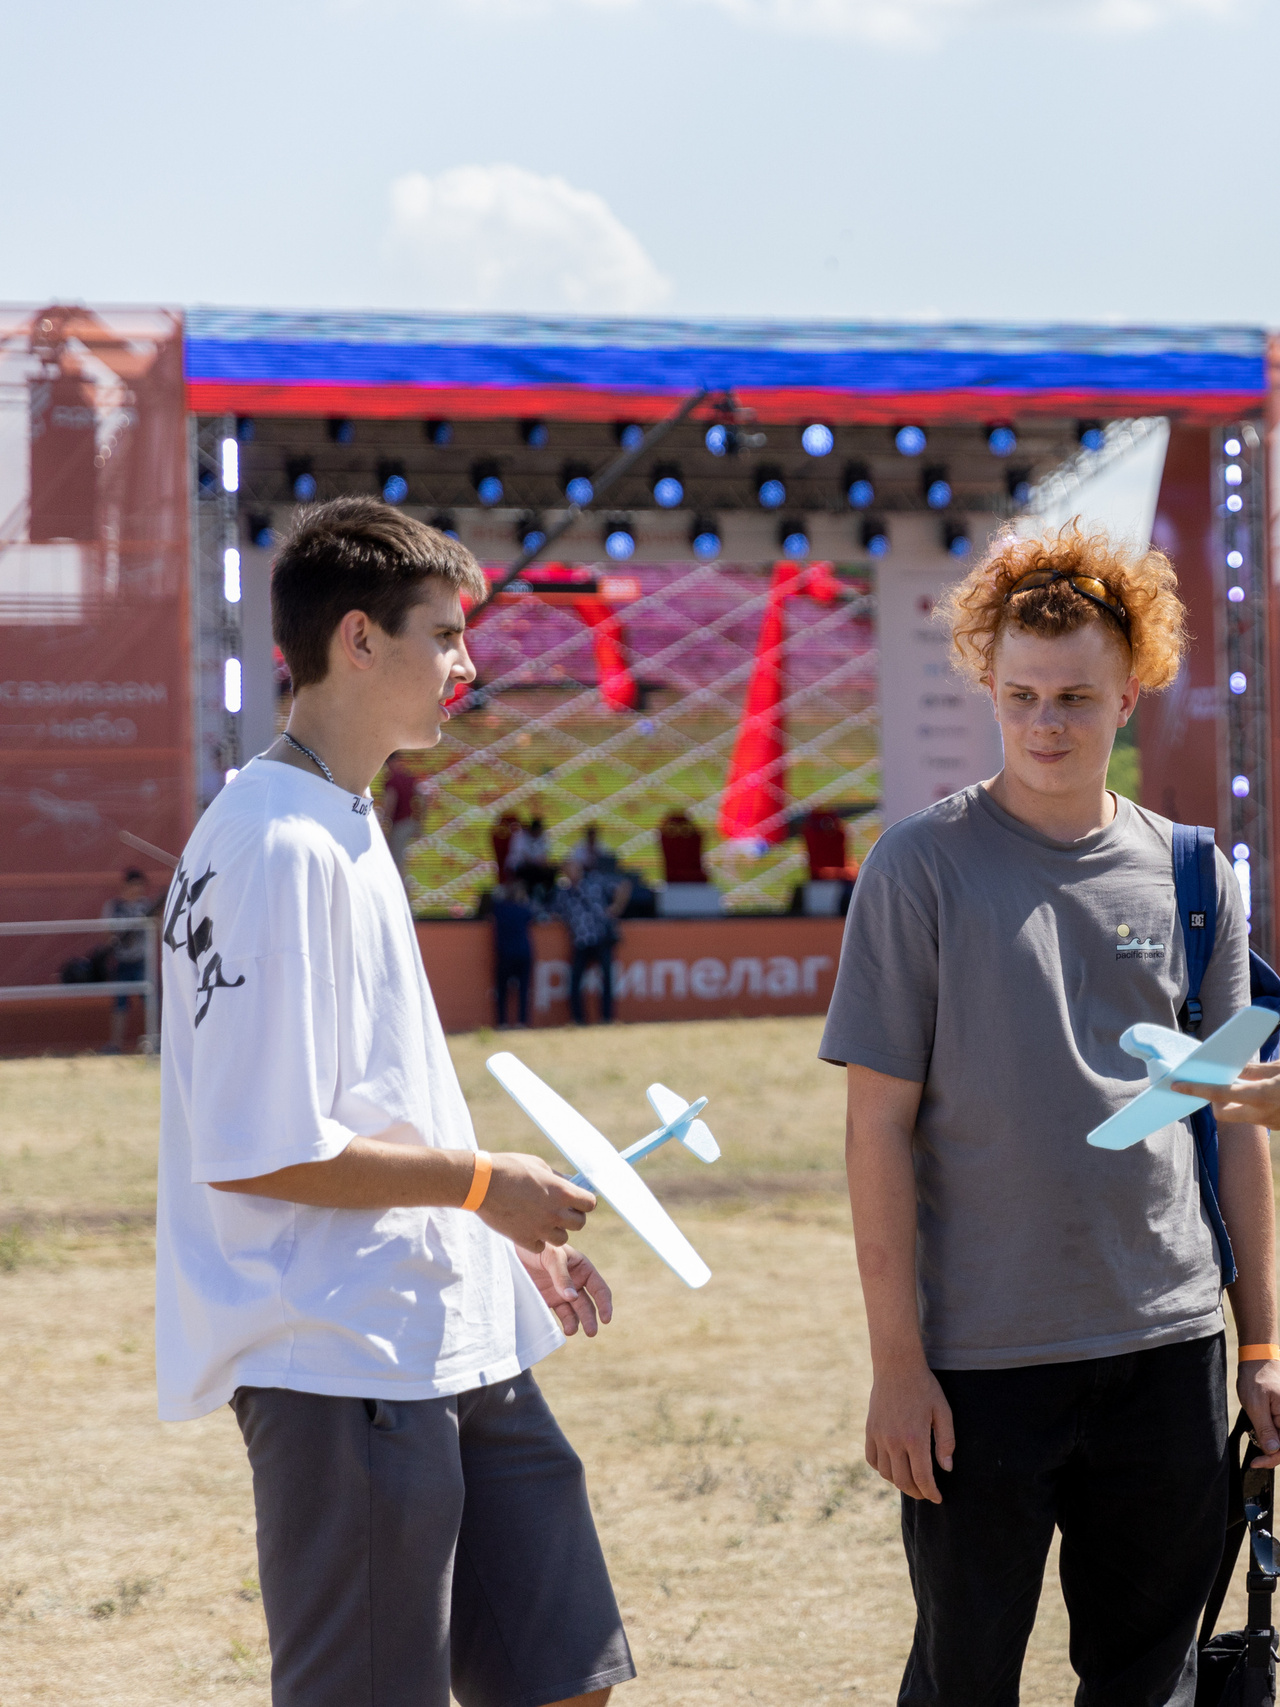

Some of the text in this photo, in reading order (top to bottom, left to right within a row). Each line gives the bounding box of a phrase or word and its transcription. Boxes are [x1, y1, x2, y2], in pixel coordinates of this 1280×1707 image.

[0, 681, 168, 706] сваиваем
[1115, 950, 1165, 961] pacific parks
[492, 955, 832, 1012] рипелаг
